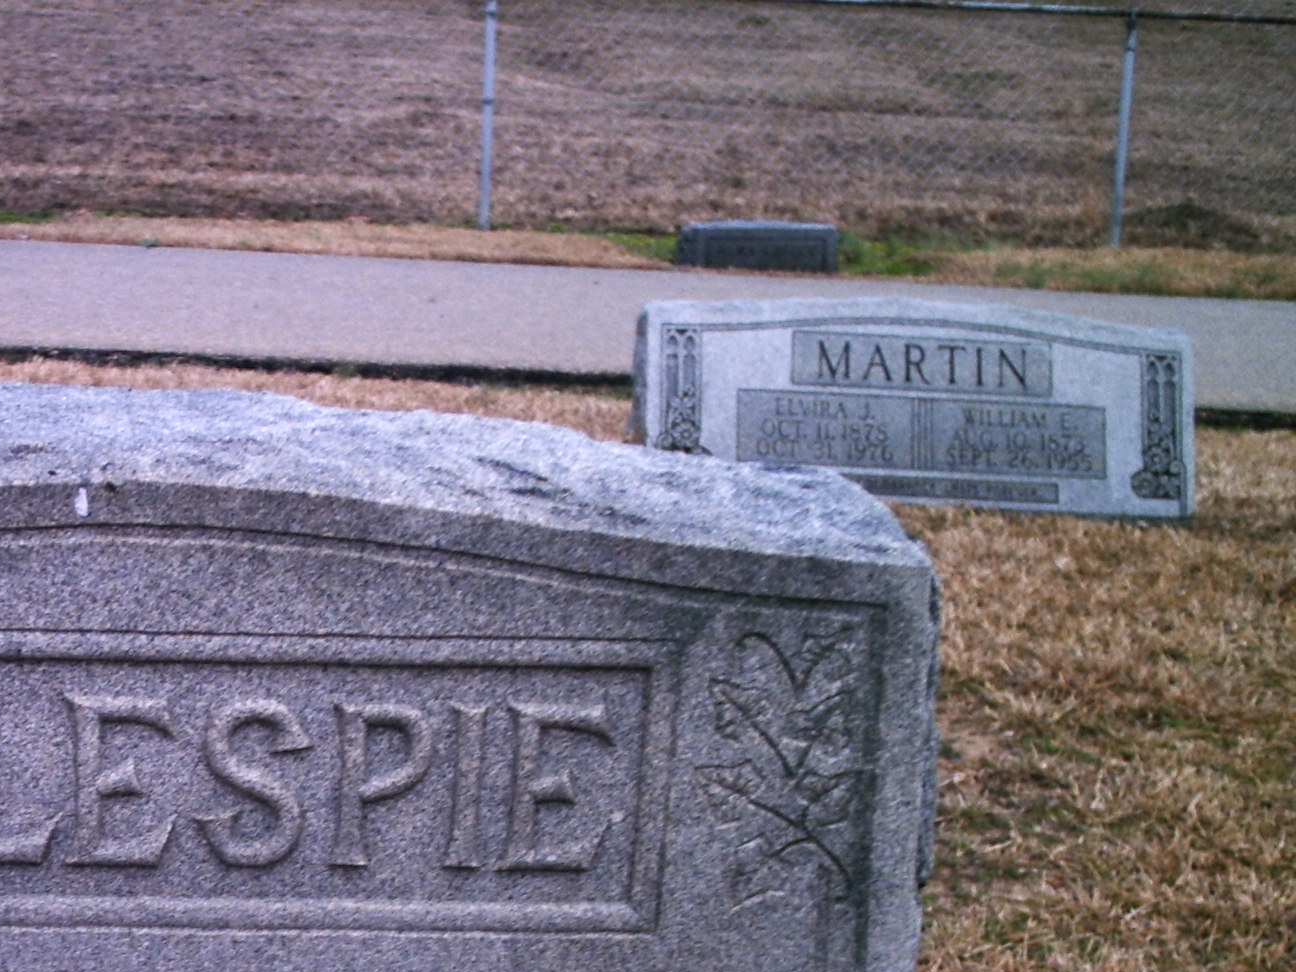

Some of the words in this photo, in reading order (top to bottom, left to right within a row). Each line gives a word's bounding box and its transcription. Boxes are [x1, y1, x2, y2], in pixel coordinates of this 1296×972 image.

[816, 341, 1029, 390] MARTIN
[775, 396, 848, 419] ELVIRA
[962, 408, 1047, 428] WILLIAM
[761, 418, 808, 439] OCT.
[846, 441, 894, 463] 1976
